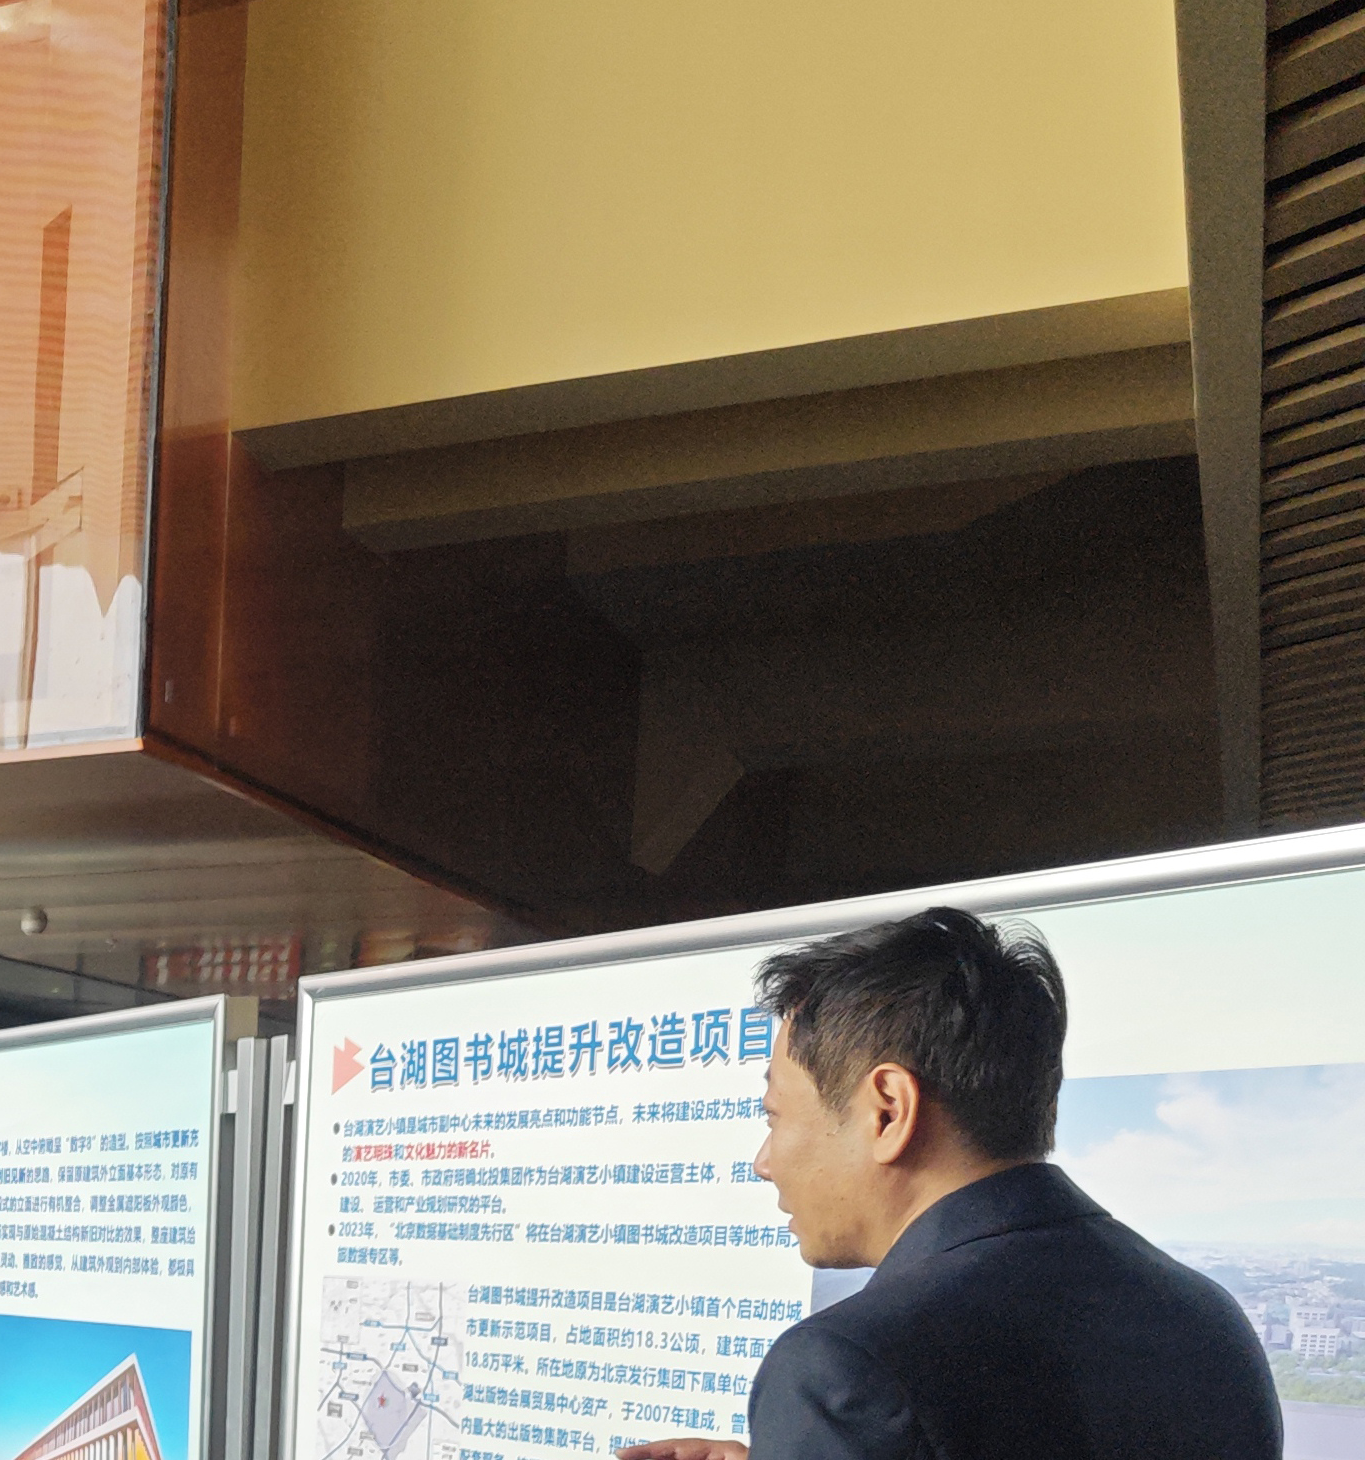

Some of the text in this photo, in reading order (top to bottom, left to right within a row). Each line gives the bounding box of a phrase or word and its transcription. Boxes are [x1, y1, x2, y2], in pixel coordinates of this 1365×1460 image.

[369, 1006, 775, 1093] 台湖图书城提升改造项目
[337, 1221, 800, 1249] 2023年，“北京数据基础制度先行区”将在台湖演艺小镇图书城改造项目等地布局
[467, 1284, 804, 1322] 台湖图书城提升改造项目是台湖演艺小镇首个启动的城
[465, 1350, 754, 1397] 18.8万平米。所在地原为北京发行集团下属单位
[461, 1382, 750, 1436] 湖出版物会展贸易中心资产，于2007年建成，曾
